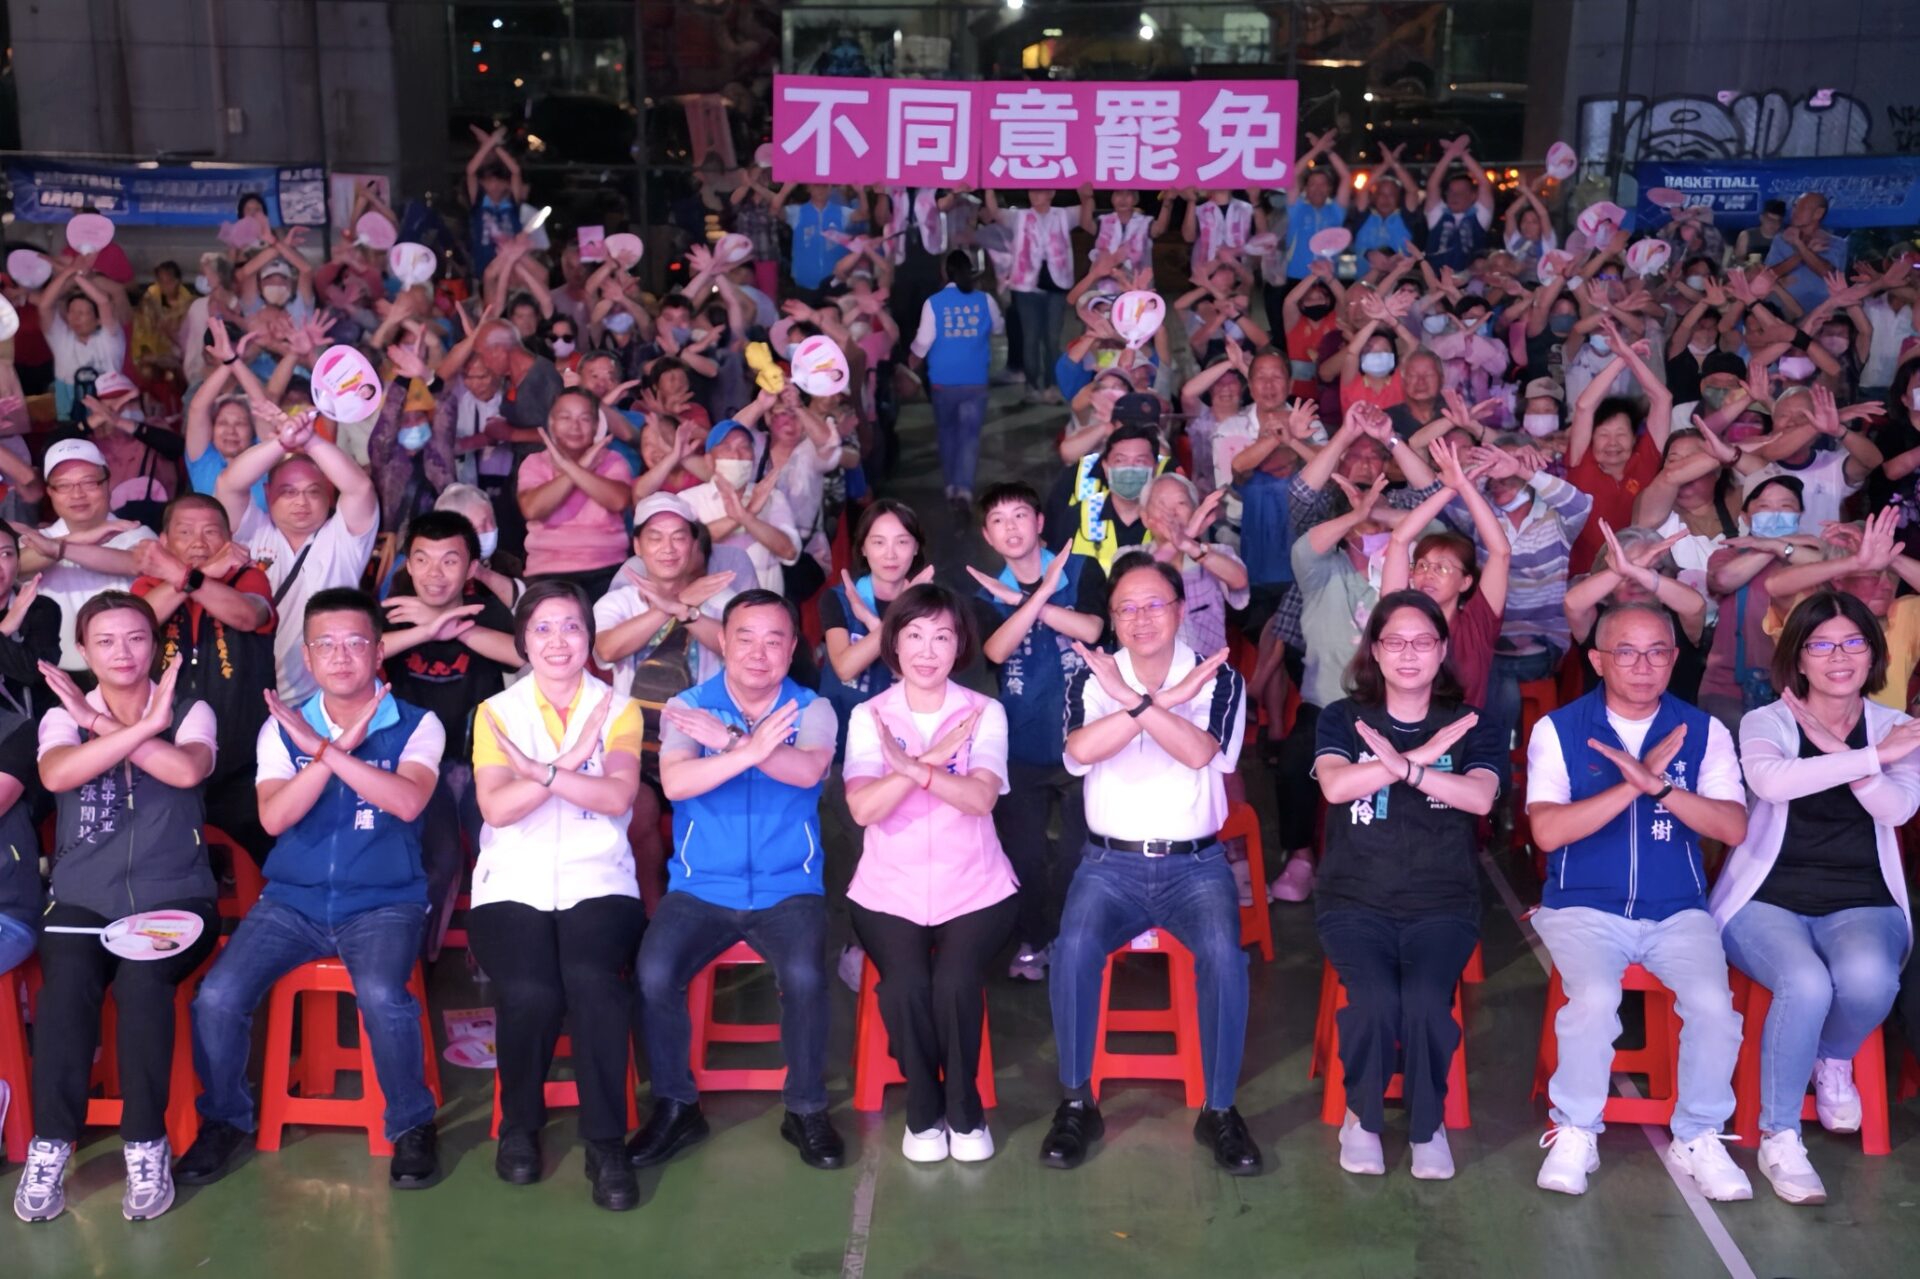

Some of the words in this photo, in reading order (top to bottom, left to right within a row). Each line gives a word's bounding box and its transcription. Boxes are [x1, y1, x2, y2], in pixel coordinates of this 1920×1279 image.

[781, 87, 1287, 183] 不同意罷免
[1664, 175, 1760, 189] BASKETBALL
